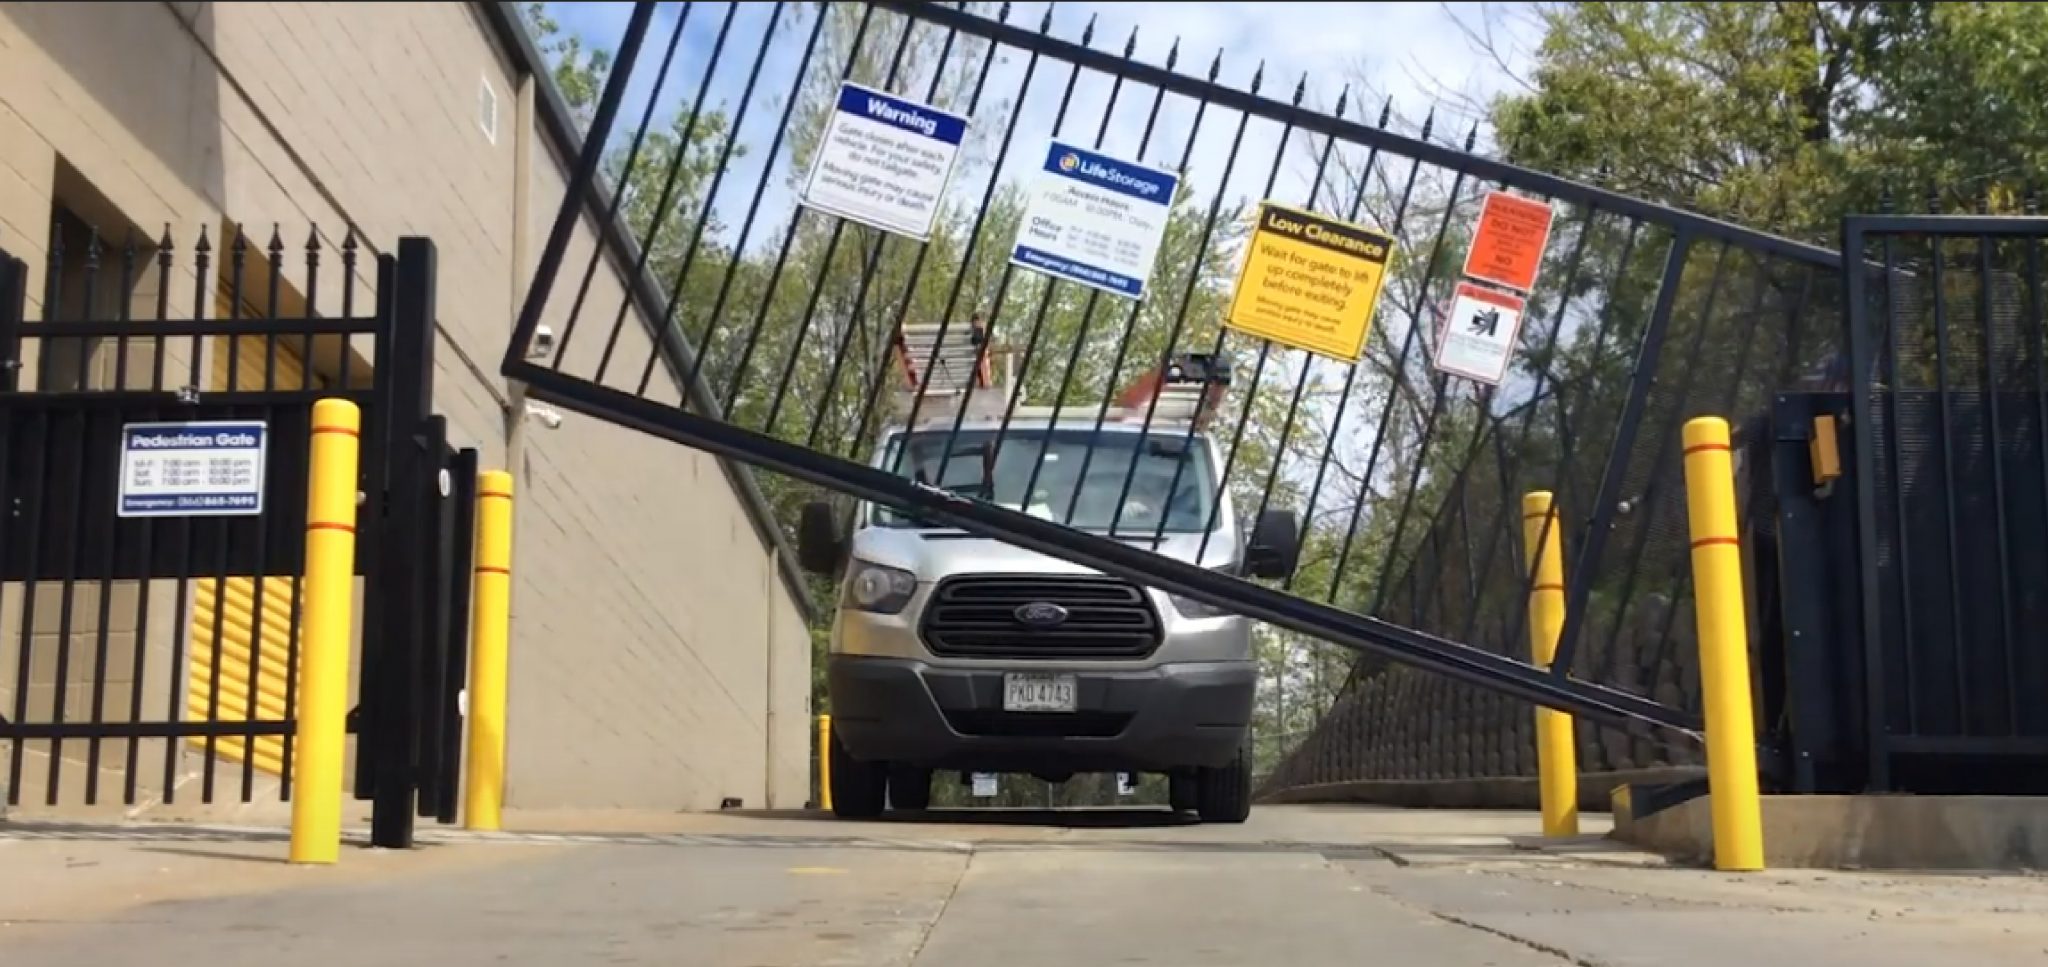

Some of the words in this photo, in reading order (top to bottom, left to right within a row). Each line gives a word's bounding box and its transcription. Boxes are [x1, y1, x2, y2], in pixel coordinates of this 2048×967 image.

[868, 97, 937, 135] Warning
[838, 122, 863, 137] Gate
[896, 140, 919, 153] after
[921, 149, 945, 162] each
[849, 151, 861, 162] do
[863, 155, 880, 166] not
[888, 152, 909, 166] your
[823, 161, 859, 182] Moving
[860, 174, 882, 189] gate
[1268, 213, 1303, 235] Low
[1305, 223, 1385, 257] Clearance
[1260, 243, 1288, 261] Wait
[1289, 251, 1306, 266] for
[1308, 259, 1337, 275] gate
[1339, 266, 1352, 278] to
[1262, 277, 1303, 297] before
[1267, 263, 1283, 278] up
[1285, 269, 1353, 298] completely
[131, 433, 213, 448] Pedestrian
[215, 432, 256, 447] Gate
[1037, 683, 1071, 704] 4743
